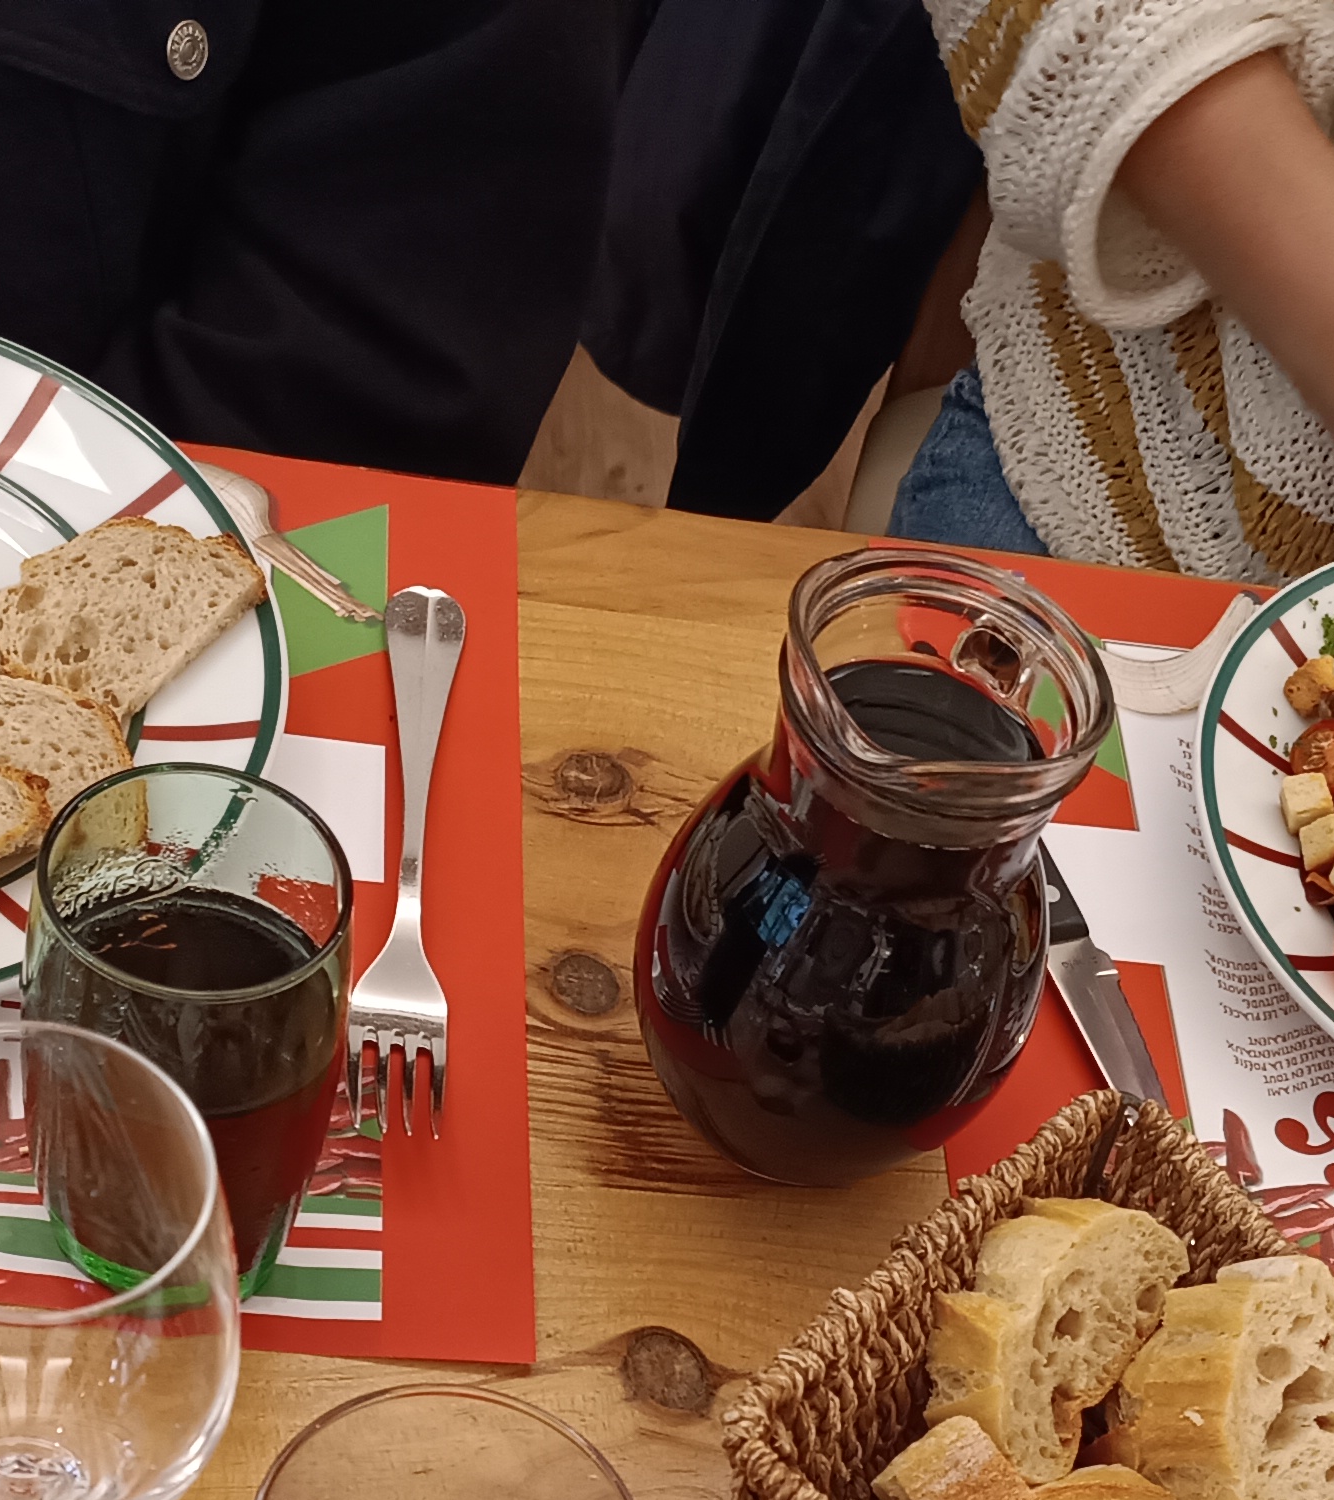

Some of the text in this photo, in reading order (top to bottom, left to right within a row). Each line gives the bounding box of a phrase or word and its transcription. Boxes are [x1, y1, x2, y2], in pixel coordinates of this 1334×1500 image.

[1217, 979, 1246, 995] MOTS
[1249, 986, 1266, 996] DES
[1263, 1009, 1277, 1021] LES
[1268, 1061, 1283, 1071] LA
[1284, 1056, 1297, 1066] DE
[1263, 1073, 1289, 1084] TOUT
[1291, 1068, 1304, 1079] EN
[1267, 1086, 1293, 1096] AMI
[1292, 1081, 1308, 1093] UN
